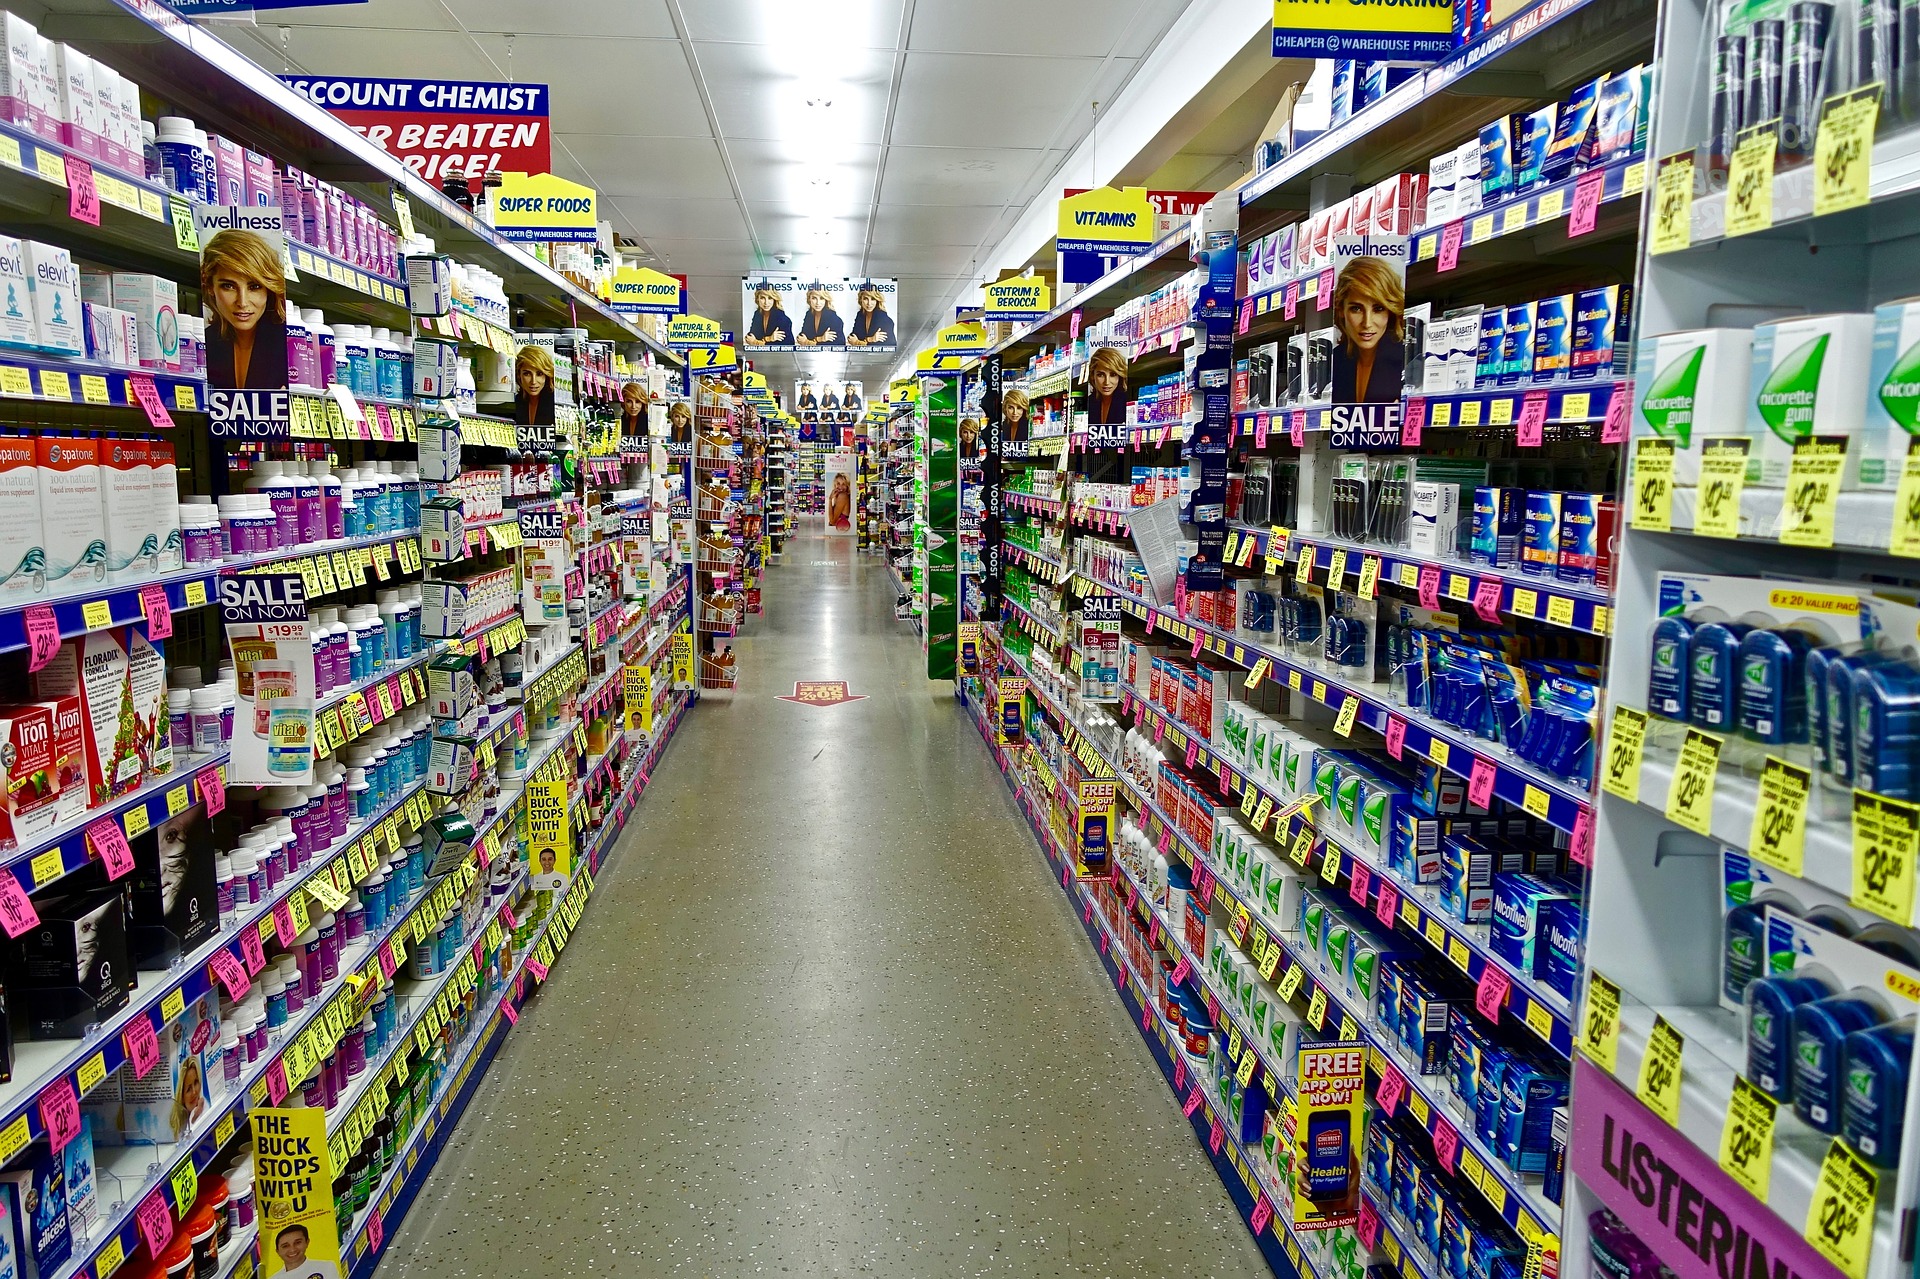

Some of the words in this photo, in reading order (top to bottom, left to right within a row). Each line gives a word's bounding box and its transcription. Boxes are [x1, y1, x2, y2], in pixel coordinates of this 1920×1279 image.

[1275, 36, 1325, 49] CHEAPER
[1325, 35, 1340, 51] @
[1341, 38, 1410, 51] WAREHOUSE
[1413, 40, 1452, 52] PRICES
[1445, 55, 1465, 78] REAL
[1465, 28, 1510, 68] BRANDS!
[1512, 12, 1538, 40] REAL
[14, 56, 39, 74] women's
[71, 85, 93, 101] women's
[418, 83, 541, 111] CHEMIST
[99, 99, 120, 114] women's
[396, 123, 541, 150] BEATEN
[393, 153, 502, 180] RICE!
[499, 196, 543, 212] SUPER
[547, 197, 592, 213] FOODS
[201, 206, 281, 230] wellness
[1075, 210, 1137, 228] VITAMINS
[1058, 242, 1085, 250] CHEAPER
[1093, 244, 1130, 252] WAREHOUSE
[1338, 235, 1405, 256] wellness
[38, 260, 70, 285] elevit
[155, 280, 177, 297] FABFOL
[614, 283, 645, 294] SUPER
[646, 283, 676, 295] FOODS
[745, 276, 793, 291] wellness
[797, 277, 845, 291] wellness
[848, 277, 896, 292] wellness
[989, 286, 1032, 297] CENTRUM
[1033, 286, 1041, 297] &
[997, 297, 1037, 307] BEROCCA
[1537, 316, 1565, 328] Nicabate
[1577, 308, 1608, 323] Nicabate
[672, 323, 704, 331] NATURAL
[706, 323, 712, 331] &
[1506, 322, 1529, 334] Nicabate
[669, 331, 718, 339] HOMEOPATHIC
[945, 333, 978, 342] VITAMINS
[1089, 336, 1128, 348] wellness
[706, 349, 718, 365] 2
[933, 354, 944, 368] 2
[745, 376, 754, 387] 2
[991, 358, 999, 394] VOOST
[900, 390, 909, 401] 2
[1643, 395, 1693, 411] nicorette
[1758, 390, 1815, 406] nicorette
[210, 393, 289, 421] SALE
[1332, 406, 1400, 432] SALE
[1667, 410, 1691, 426] gum
[1785, 407, 1813, 428] gum
[210, 421, 241, 436] ON
[243, 421, 289, 436] NOW!
[517, 426, 555, 442] SALE
[1089, 425, 1126, 440] SALE
[517, 441, 531, 449] ON
[532, 441, 556, 449] NOW!
[621, 436, 648, 447] SALE
[990, 421, 999, 456] VOOST
[1089, 439, 1102, 448] ON
[1104, 439, 1126, 448] NOW!
[1331, 432, 1354, 446] ON
[1359, 431, 1400, 446] NOW!
[1002, 442, 1027, 452] SALE
[62, 448, 94, 464] spatone
[122, 449, 148, 464] spatone
[151, 449, 172, 463] spatone
[70, 472, 96, 484] natural
[265, 490, 293, 499] Ostelin
[990, 483, 998, 518] VOOST
[521, 513, 562, 530] SALE
[1525, 508, 1553, 523] Nicabate
[1564, 508, 1593, 524] Nicabate
[623, 519, 650, 530] SALE
[522, 529, 538, 537] ON
[538, 528, 563, 537] NOW!
[990, 545, 998, 579] VOOST
[220, 578, 304, 607] SALE
[1084, 597, 1120, 612] SALE
[1772, 593, 1779, 604] 6
[1789, 594, 1803, 605] 20
[1805, 599, 1834, 609] VALUE
[224, 606, 254, 620] ON
[256, 605, 307, 619] NOW!
[960, 624, 978, 632] FREE
[1105, 622, 1119, 630] $15
[84, 649, 120, 669] FLORADIX
[238, 650, 262, 661] vital
[85, 664, 109, 677] FORMULA
[626, 668, 640, 677] THE
[626, 676, 646, 684] BUCK
[1002, 681, 1024, 690] FREE
[259, 688, 283, 699] vital
[626, 684, 648, 692] STOPS
[626, 692, 645, 700] WITH
[59, 711, 80, 731] Iron
[18, 717, 48, 747] Iron
[273, 723, 297, 736] vital
[21, 742, 43, 758] VITAL
[11, 780, 24, 791] NEW
[530, 786, 550, 797] THE
[1082, 784, 1114, 797] FREE
[530, 797, 560, 808] BUCK
[1097, 797, 1114, 805] OUT
[531, 808, 564, 819] STOPS
[531, 820, 560, 831] WITH
[1304, 1052, 1361, 1077] FREE
[1300, 1079, 1329, 1093] APP
[1332, 1077, 1362, 1090] OUT
[1310, 1091, 1350, 1105] NOW!
[254, 1114, 290, 1135] THE
[258, 1136, 311, 1156] BUCK
[1317, 1135, 1341, 1143] CHEMIST
[258, 1156, 321, 1178] STOPS
[1310, 1165, 1347, 1177] Health
[259, 1178, 313, 1198] WITH
[1295, 1218, 1340, 1230] DOWNLOAD
[1341, 1217, 1358, 1225] NOW
[37, 1217, 67, 1254] silicea
